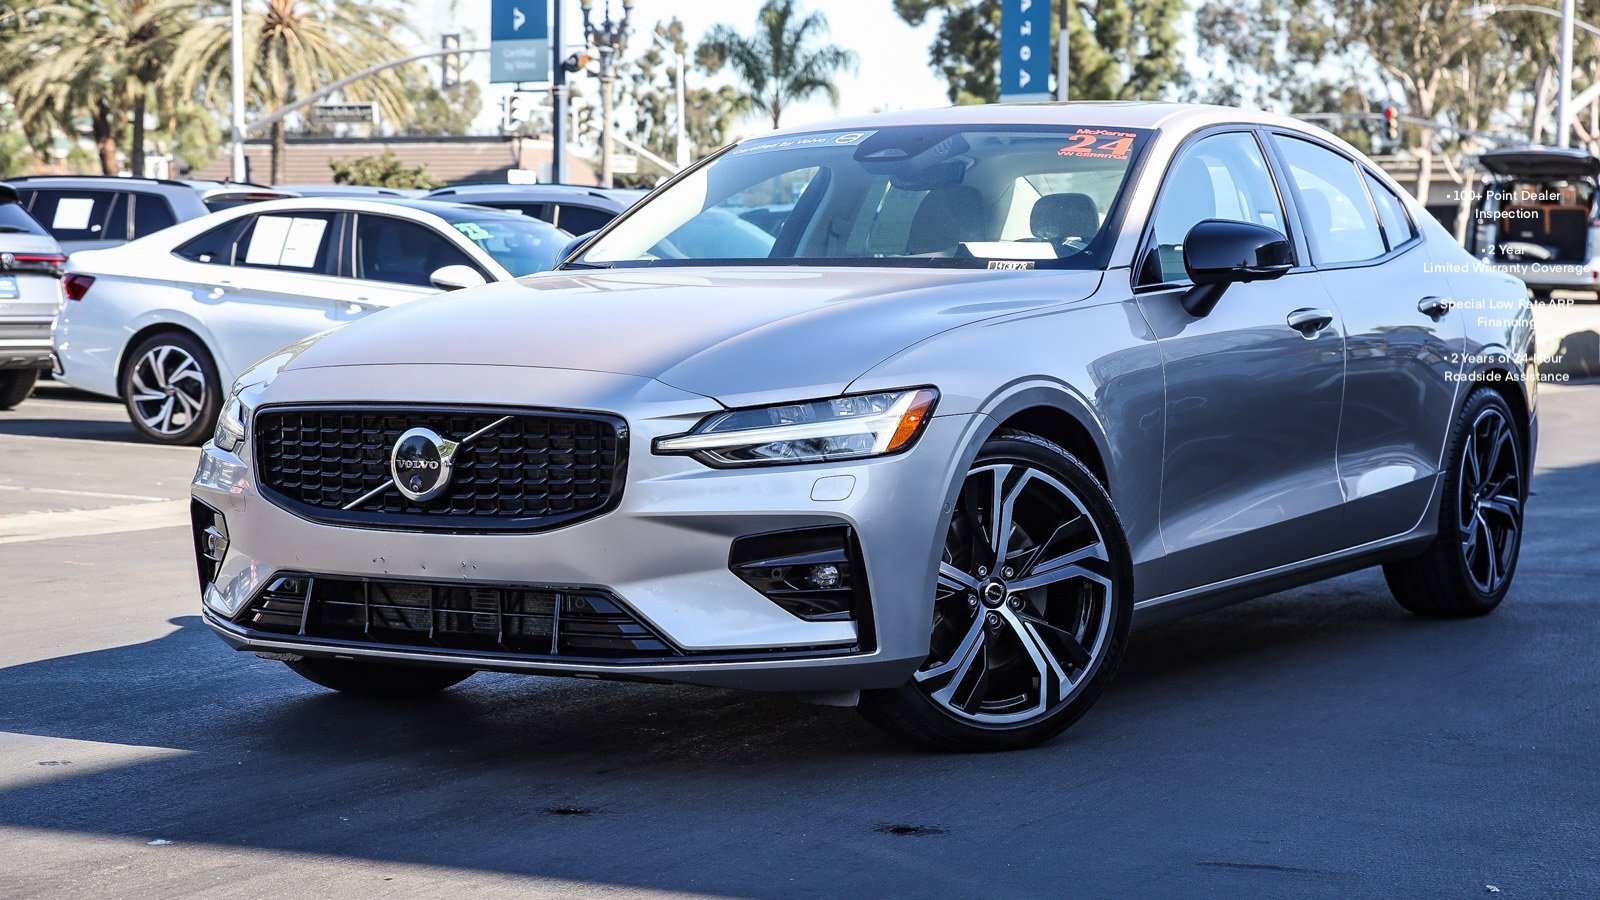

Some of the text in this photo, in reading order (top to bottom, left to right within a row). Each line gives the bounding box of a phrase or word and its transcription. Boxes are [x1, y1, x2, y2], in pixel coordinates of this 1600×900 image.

[1076, 128, 1137, 138] McKenna
[1059, 134, 1132, 156] 24
[1075, 151, 1129, 160] CERRITOS
[396, 460, 439, 469] VOLVO
